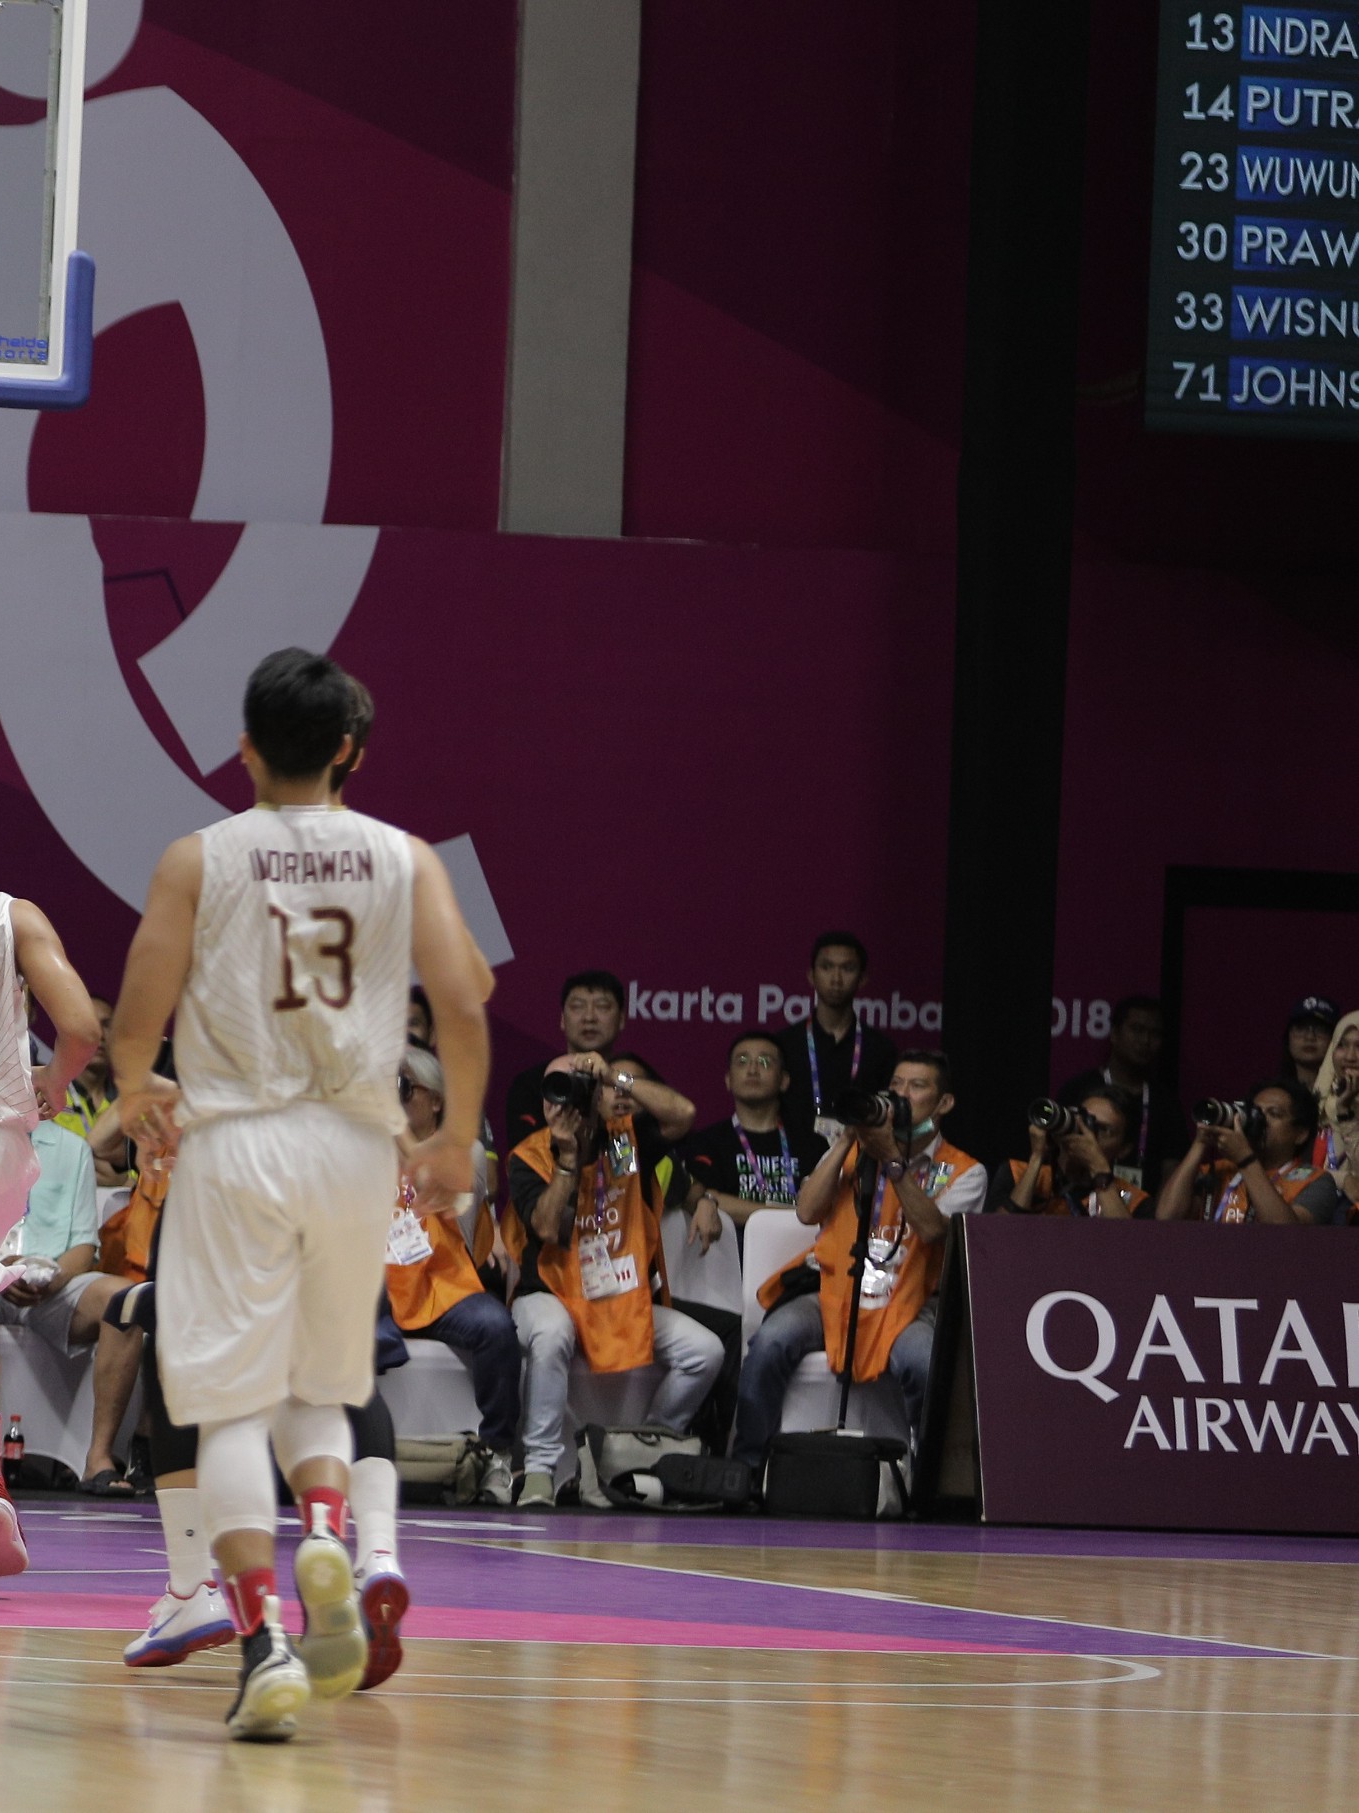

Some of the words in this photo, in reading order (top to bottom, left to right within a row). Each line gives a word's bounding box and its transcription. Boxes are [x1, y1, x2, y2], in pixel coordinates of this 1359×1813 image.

[1185, 12, 1235, 52] 13
[1183, 82, 1235, 121] 14
[1246, 85, 1359, 128] PUTR
[1179, 151, 1230, 191] 23
[1176, 221, 1228, 262] 30
[1242, 225, 1359, 267] PRAW
[1174, 291, 1224, 331] 33
[1237, 294, 1359, 338] WISN
[1173, 362, 1222, 402] 71
[268, 903, 356, 1012] 13
